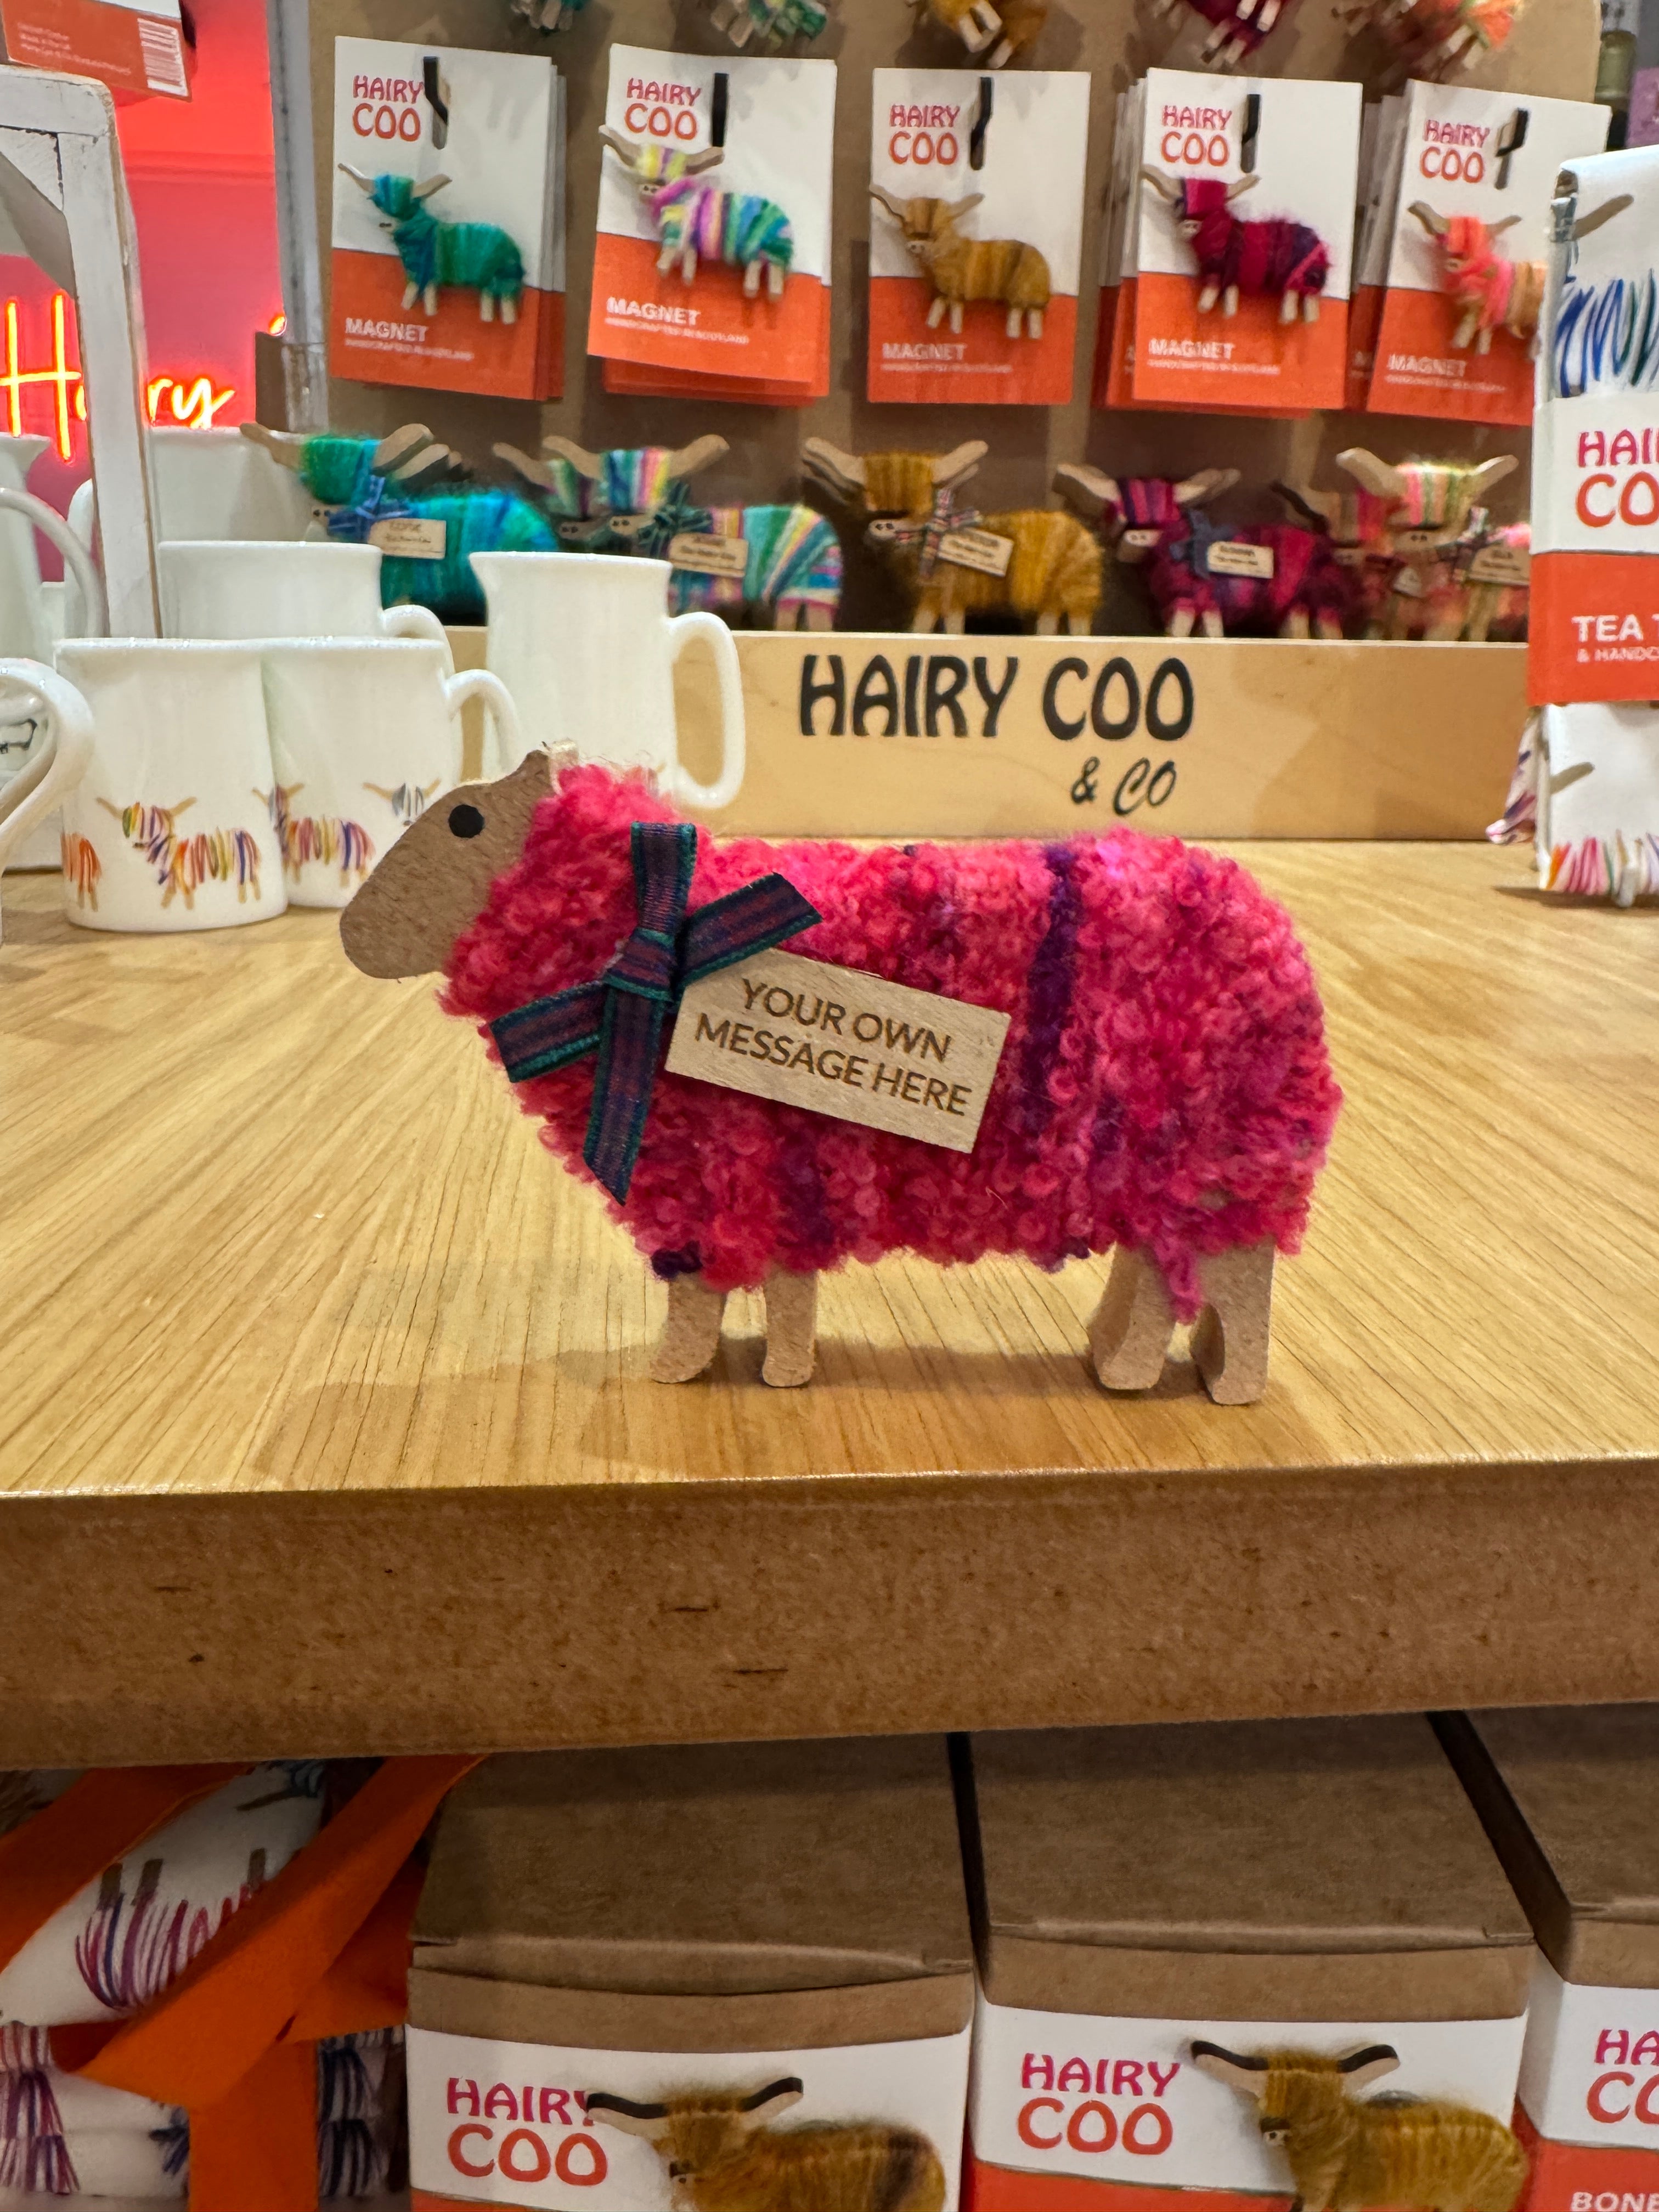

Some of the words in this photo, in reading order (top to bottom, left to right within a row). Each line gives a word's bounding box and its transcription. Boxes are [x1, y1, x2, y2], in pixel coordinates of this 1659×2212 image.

[353, 75, 424, 104] HAIRY
[627, 77, 702, 107] HAIRY
[352, 103, 421, 142] COO
[624, 103, 697, 140] COO
[889, 104, 961, 128] HAIRY
[1161, 105, 1233, 131] HAIRY
[1423, 119, 1491, 148] HAIRY
[889, 131, 958, 165] COO
[1161, 131, 1230, 167] COO
[1419, 146, 1485, 183] COO
[606, 296, 701, 326] MAGNET
[345, 317, 428, 342] MAGNET
[882, 342, 968, 360] MAGNET
[1148, 337, 1235, 360] MAGNET
[1386, 354, 1467, 377] MAGNET
[0, 293, 236, 462] Hry
[1578, 427, 1659, 469] HAI
[1571, 613, 1644, 643] TEA
[799, 653, 1019, 738] HAIRY
[1042, 656, 1194, 741] COO
[1070, 757, 1101, 805] &
[1112, 757, 1178, 816] CO
[741, 977, 847, 1036] YOUR
[852, 1012, 952, 1064] OWN
[694, 1012, 869, 1088] MESSAGE
[872, 1062, 973, 1117] HERE
[1020, 2052, 1181, 2097] HAIRY
[1017, 2096, 1174, 2156] COO
[447, 2123, 608, 2186] COO
